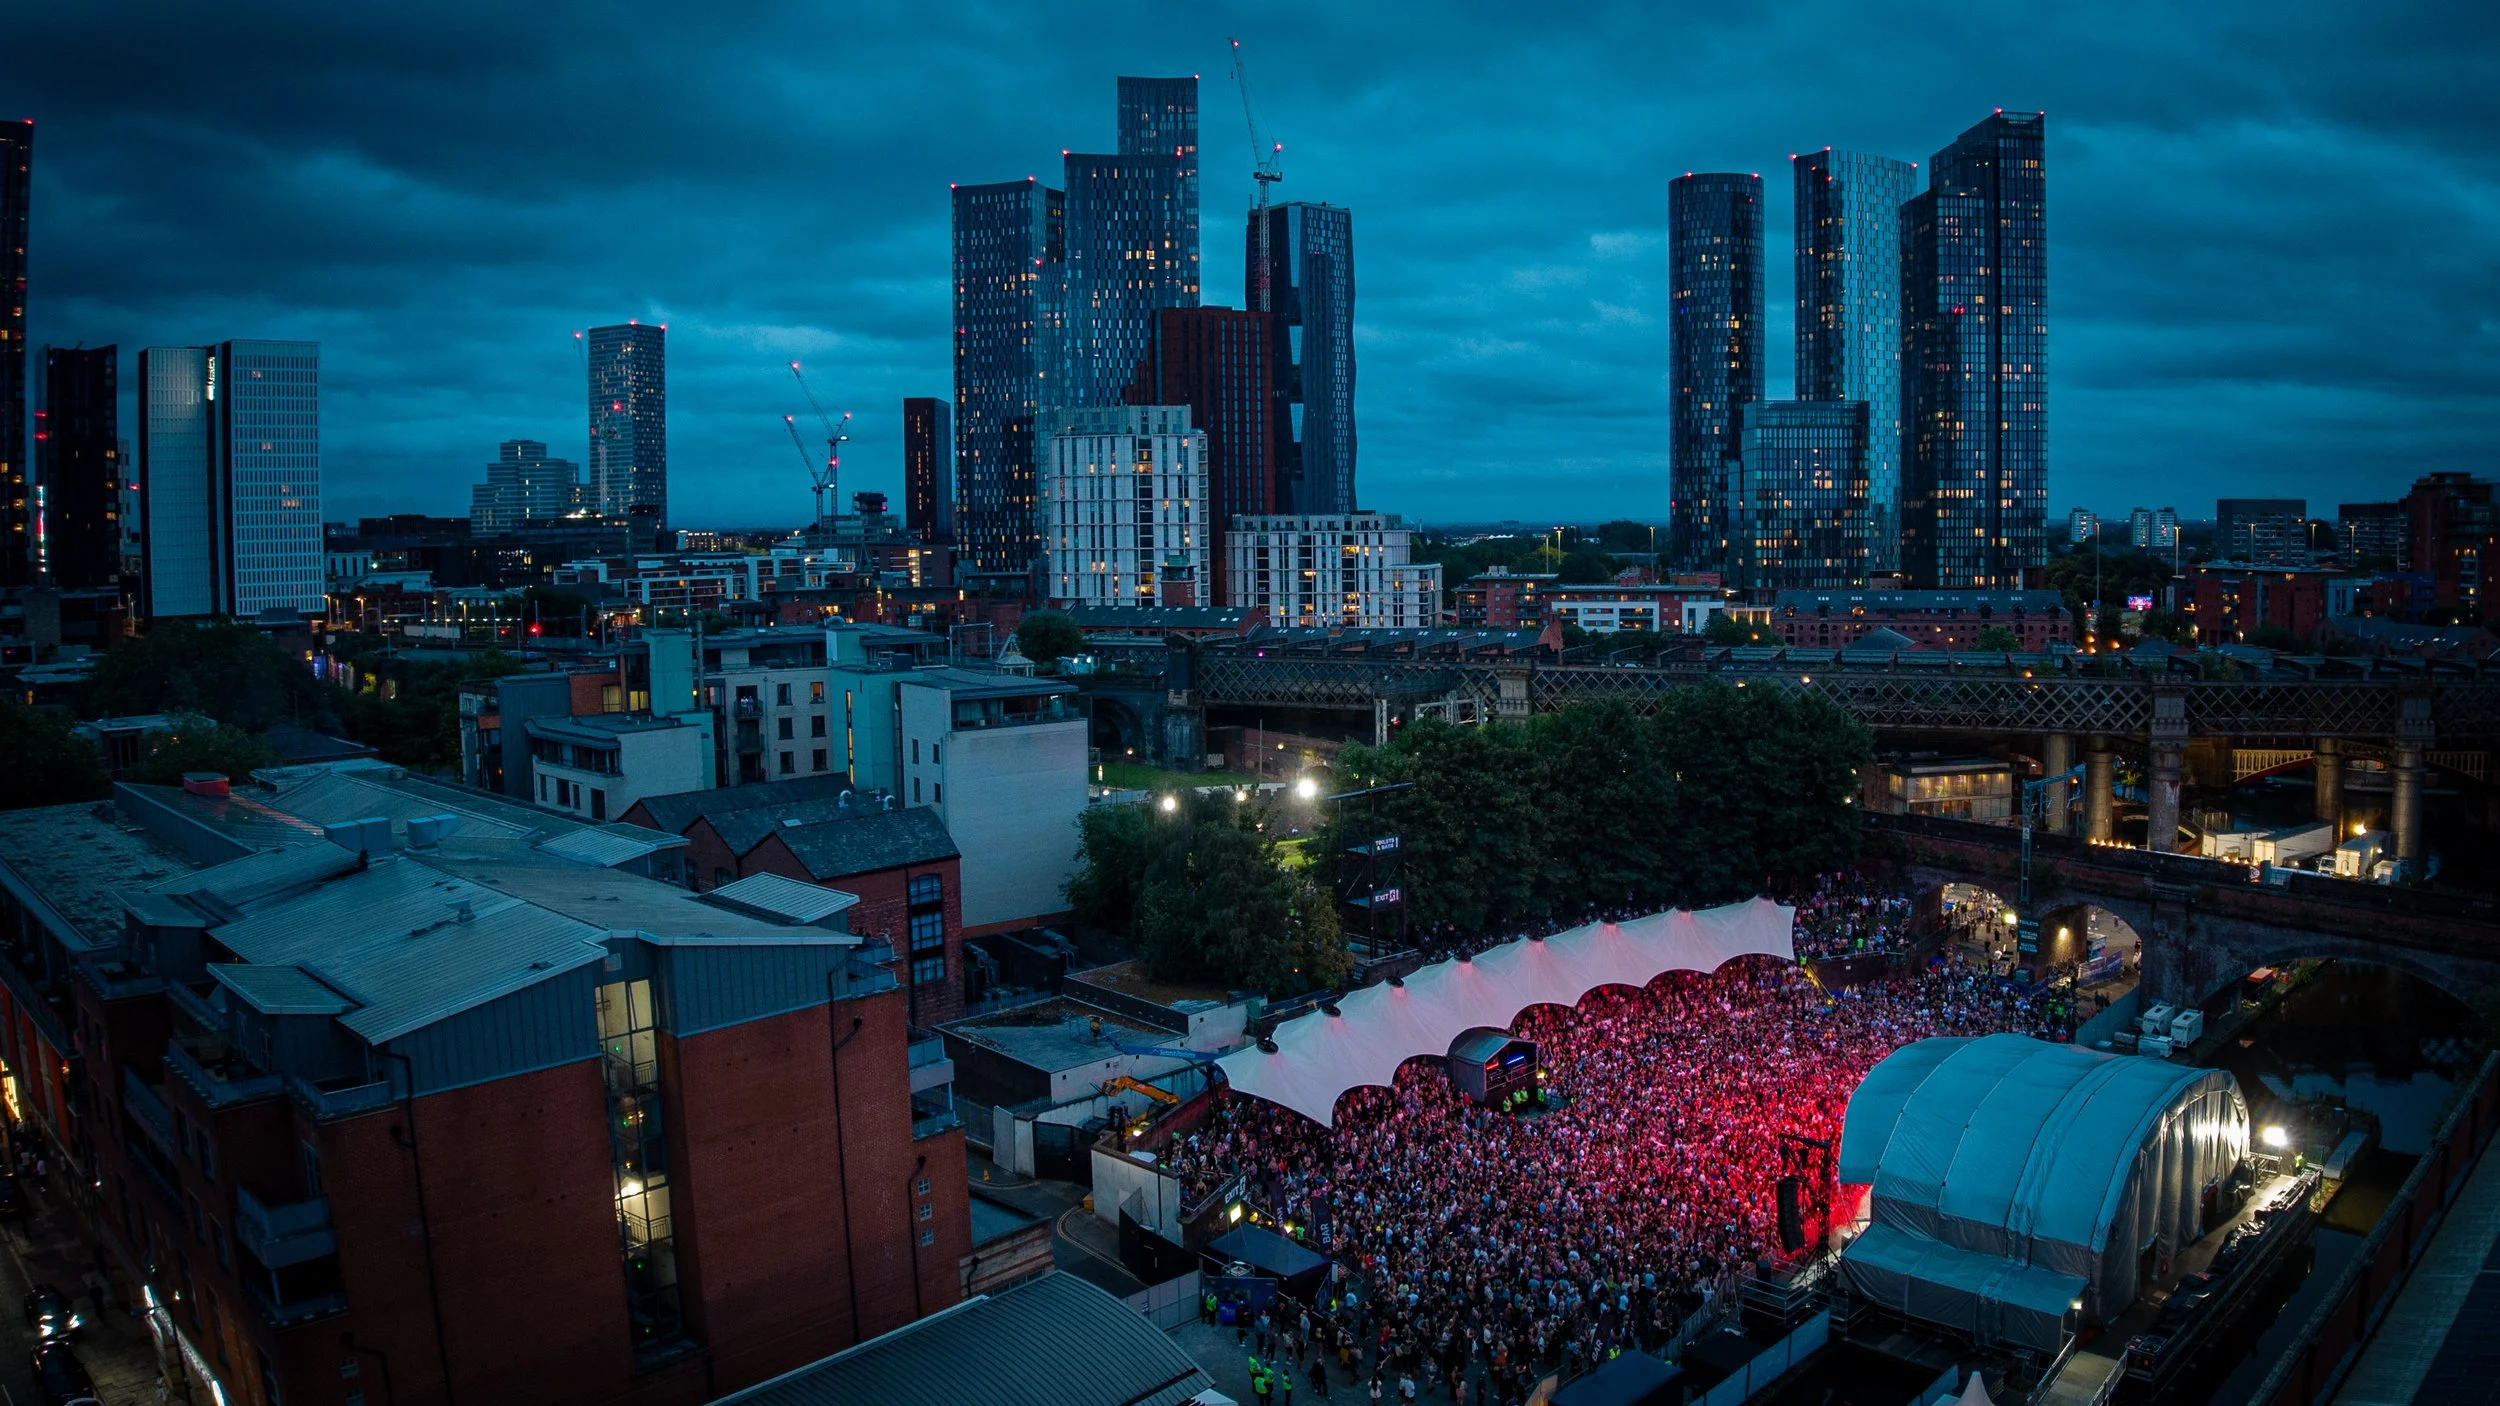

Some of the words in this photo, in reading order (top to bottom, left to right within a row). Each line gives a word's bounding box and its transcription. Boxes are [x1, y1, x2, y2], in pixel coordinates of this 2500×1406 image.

[1375, 893, 1389, 902] EXIT
[1224, 1184, 1240, 1204] EXIT
[1320, 1223, 1331, 1245] BAR
[1591, 1339, 1604, 1362] BAR
